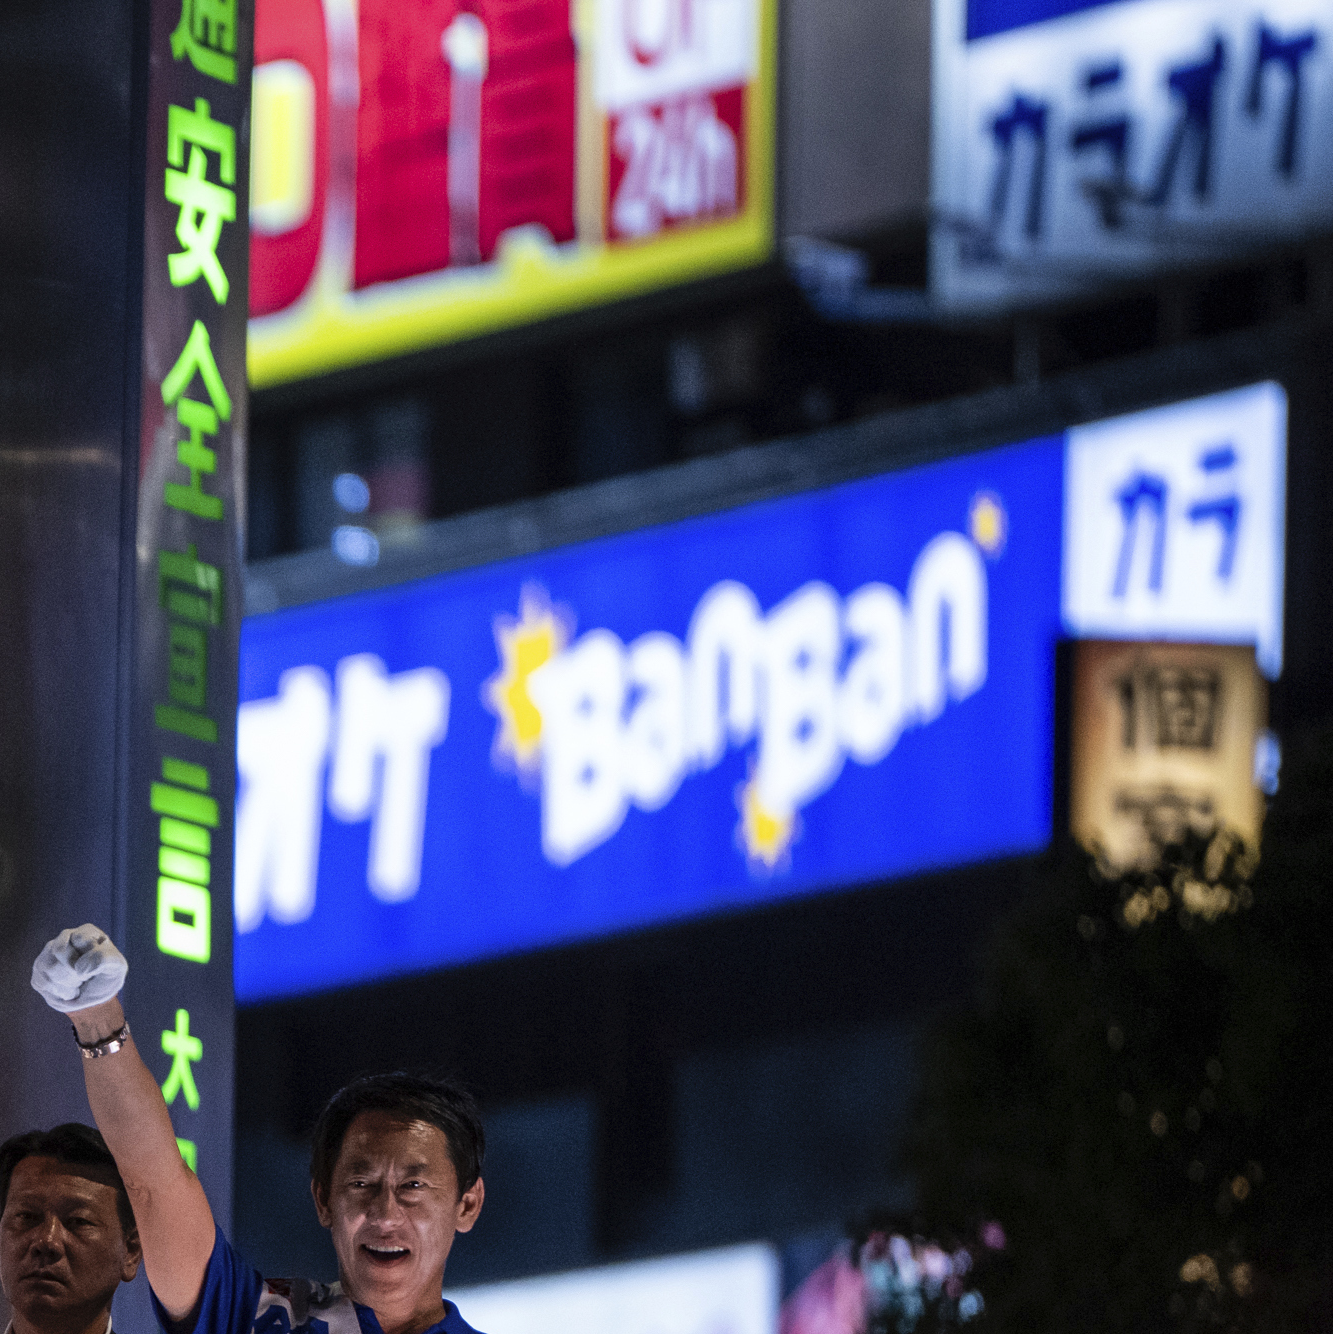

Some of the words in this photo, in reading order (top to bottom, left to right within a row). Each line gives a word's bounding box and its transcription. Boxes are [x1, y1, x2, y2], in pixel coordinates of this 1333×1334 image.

[988, 28, 1316, 240] カラオケ
[1113, 455, 1238, 600] カラ
[161, 1008, 203, 1174] 大
